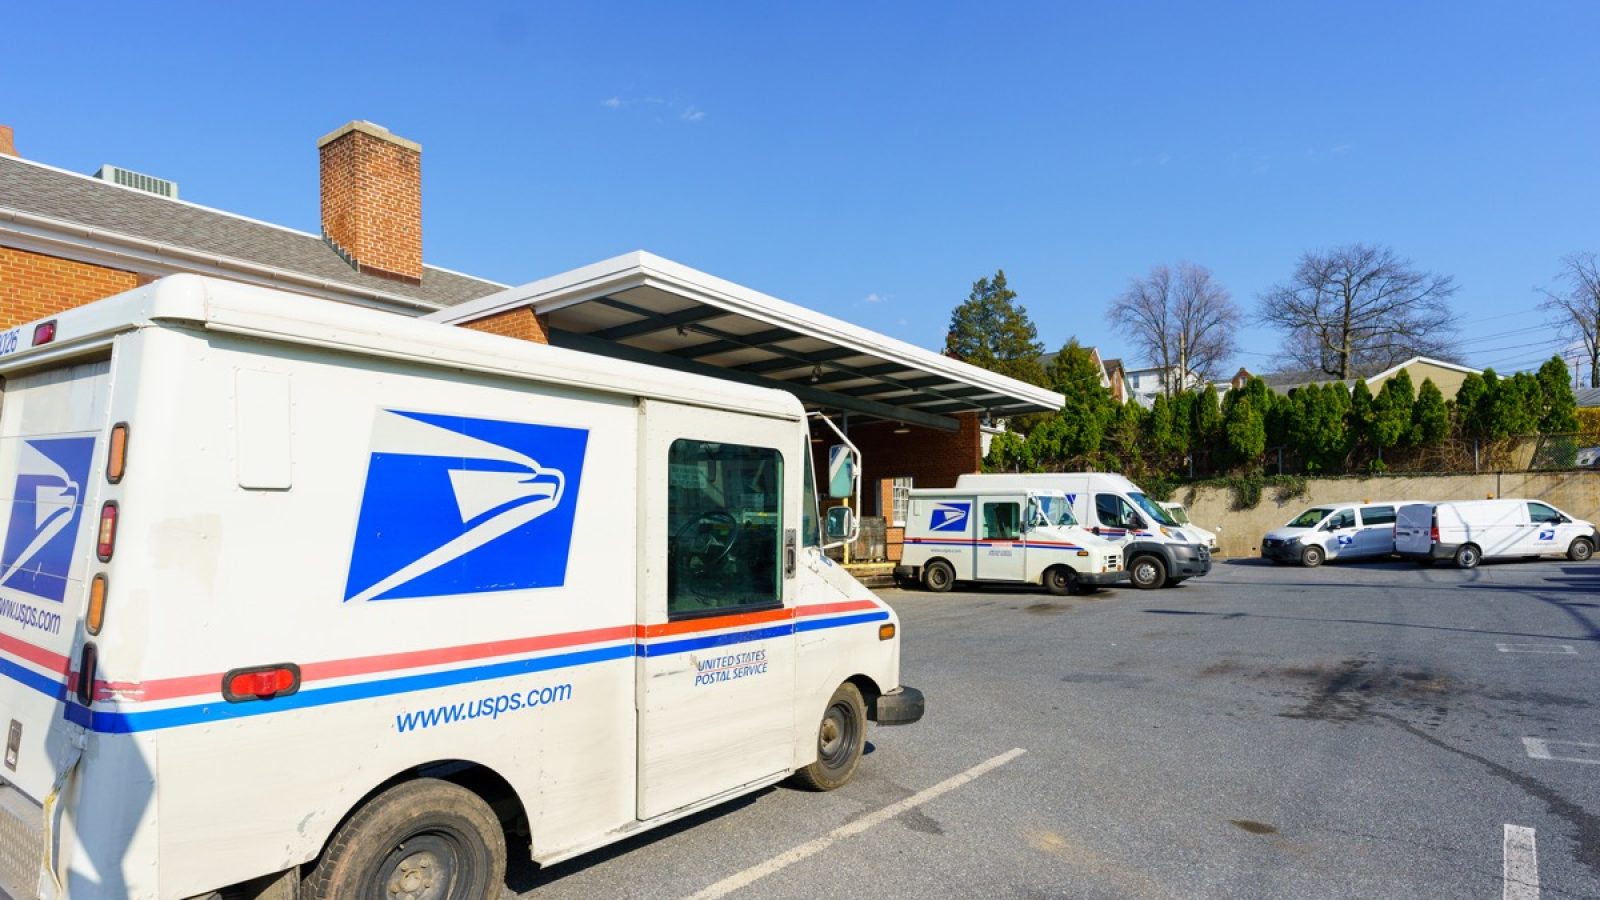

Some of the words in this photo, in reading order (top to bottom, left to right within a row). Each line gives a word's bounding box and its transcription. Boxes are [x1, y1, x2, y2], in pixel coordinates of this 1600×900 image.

[697, 655, 734, 671] UNITED
[736, 649, 765, 665] STATES
[695, 670, 731, 686] POSTAL
[733, 662, 767, 679] SERVICE
[396, 683, 572, 732] www.usps.com
